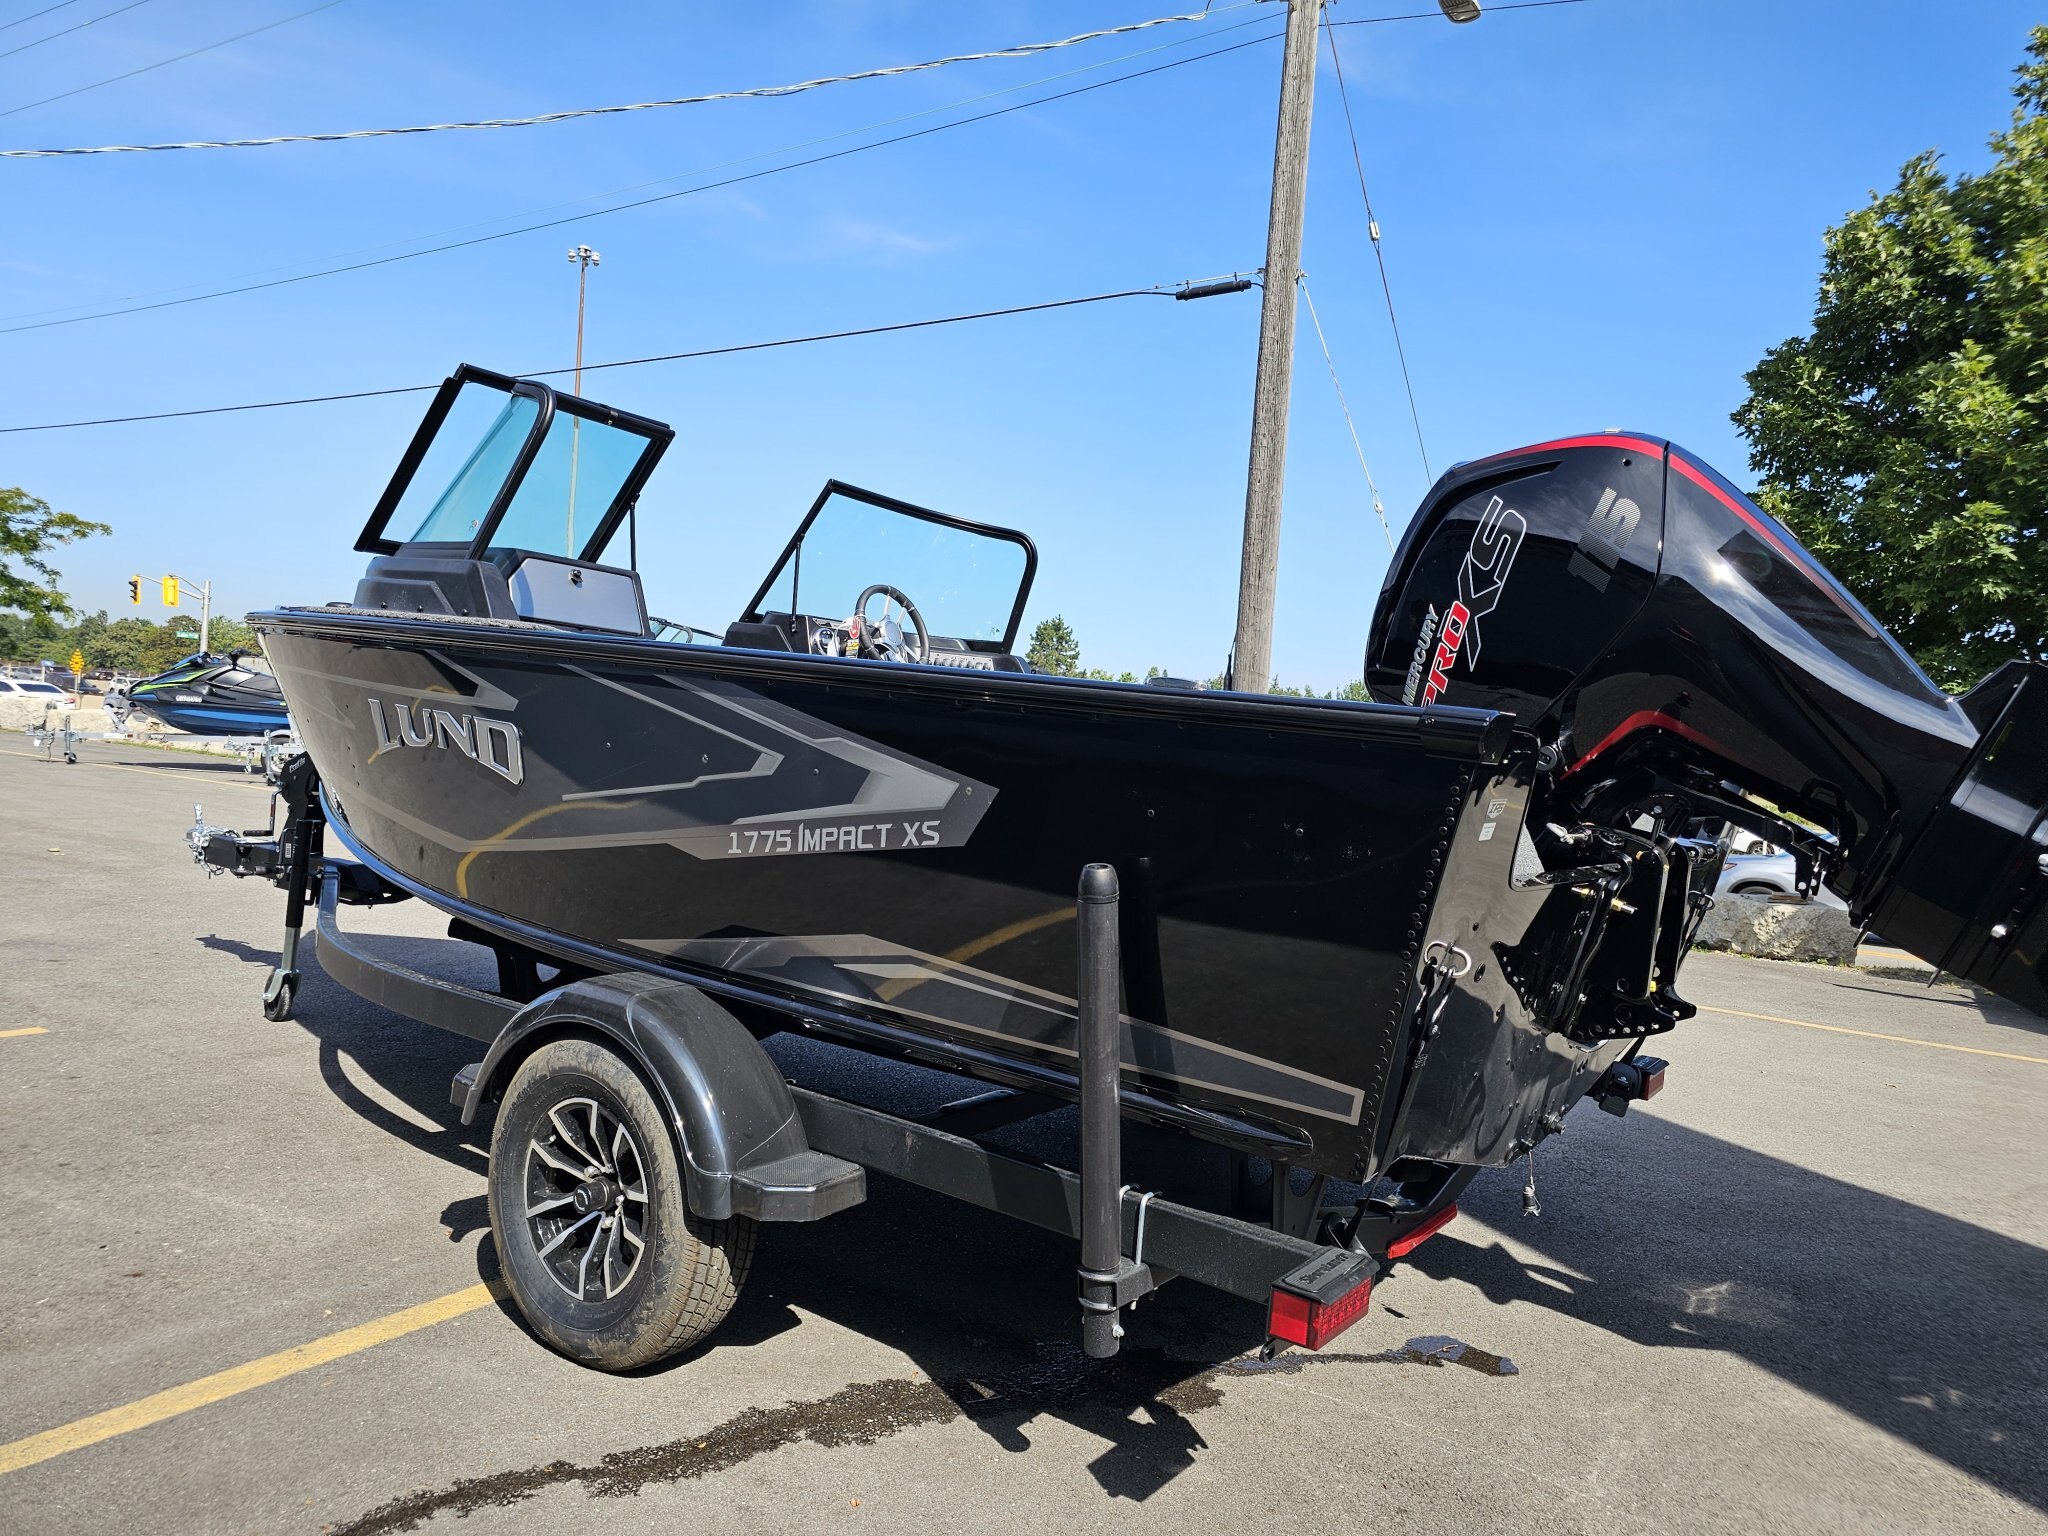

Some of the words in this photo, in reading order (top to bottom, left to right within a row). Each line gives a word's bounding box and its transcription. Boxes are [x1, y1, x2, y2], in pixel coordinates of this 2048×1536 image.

[1437, 495, 1527, 672] XS
[1567, 486, 1641, 594] 115
[1402, 603, 1439, 707] MERCURY
[368, 698, 524, 785] LUND
[727, 829, 792, 854] 1775
[797, 823, 893, 852] IMPACT
[901, 820, 941, 847] XS
